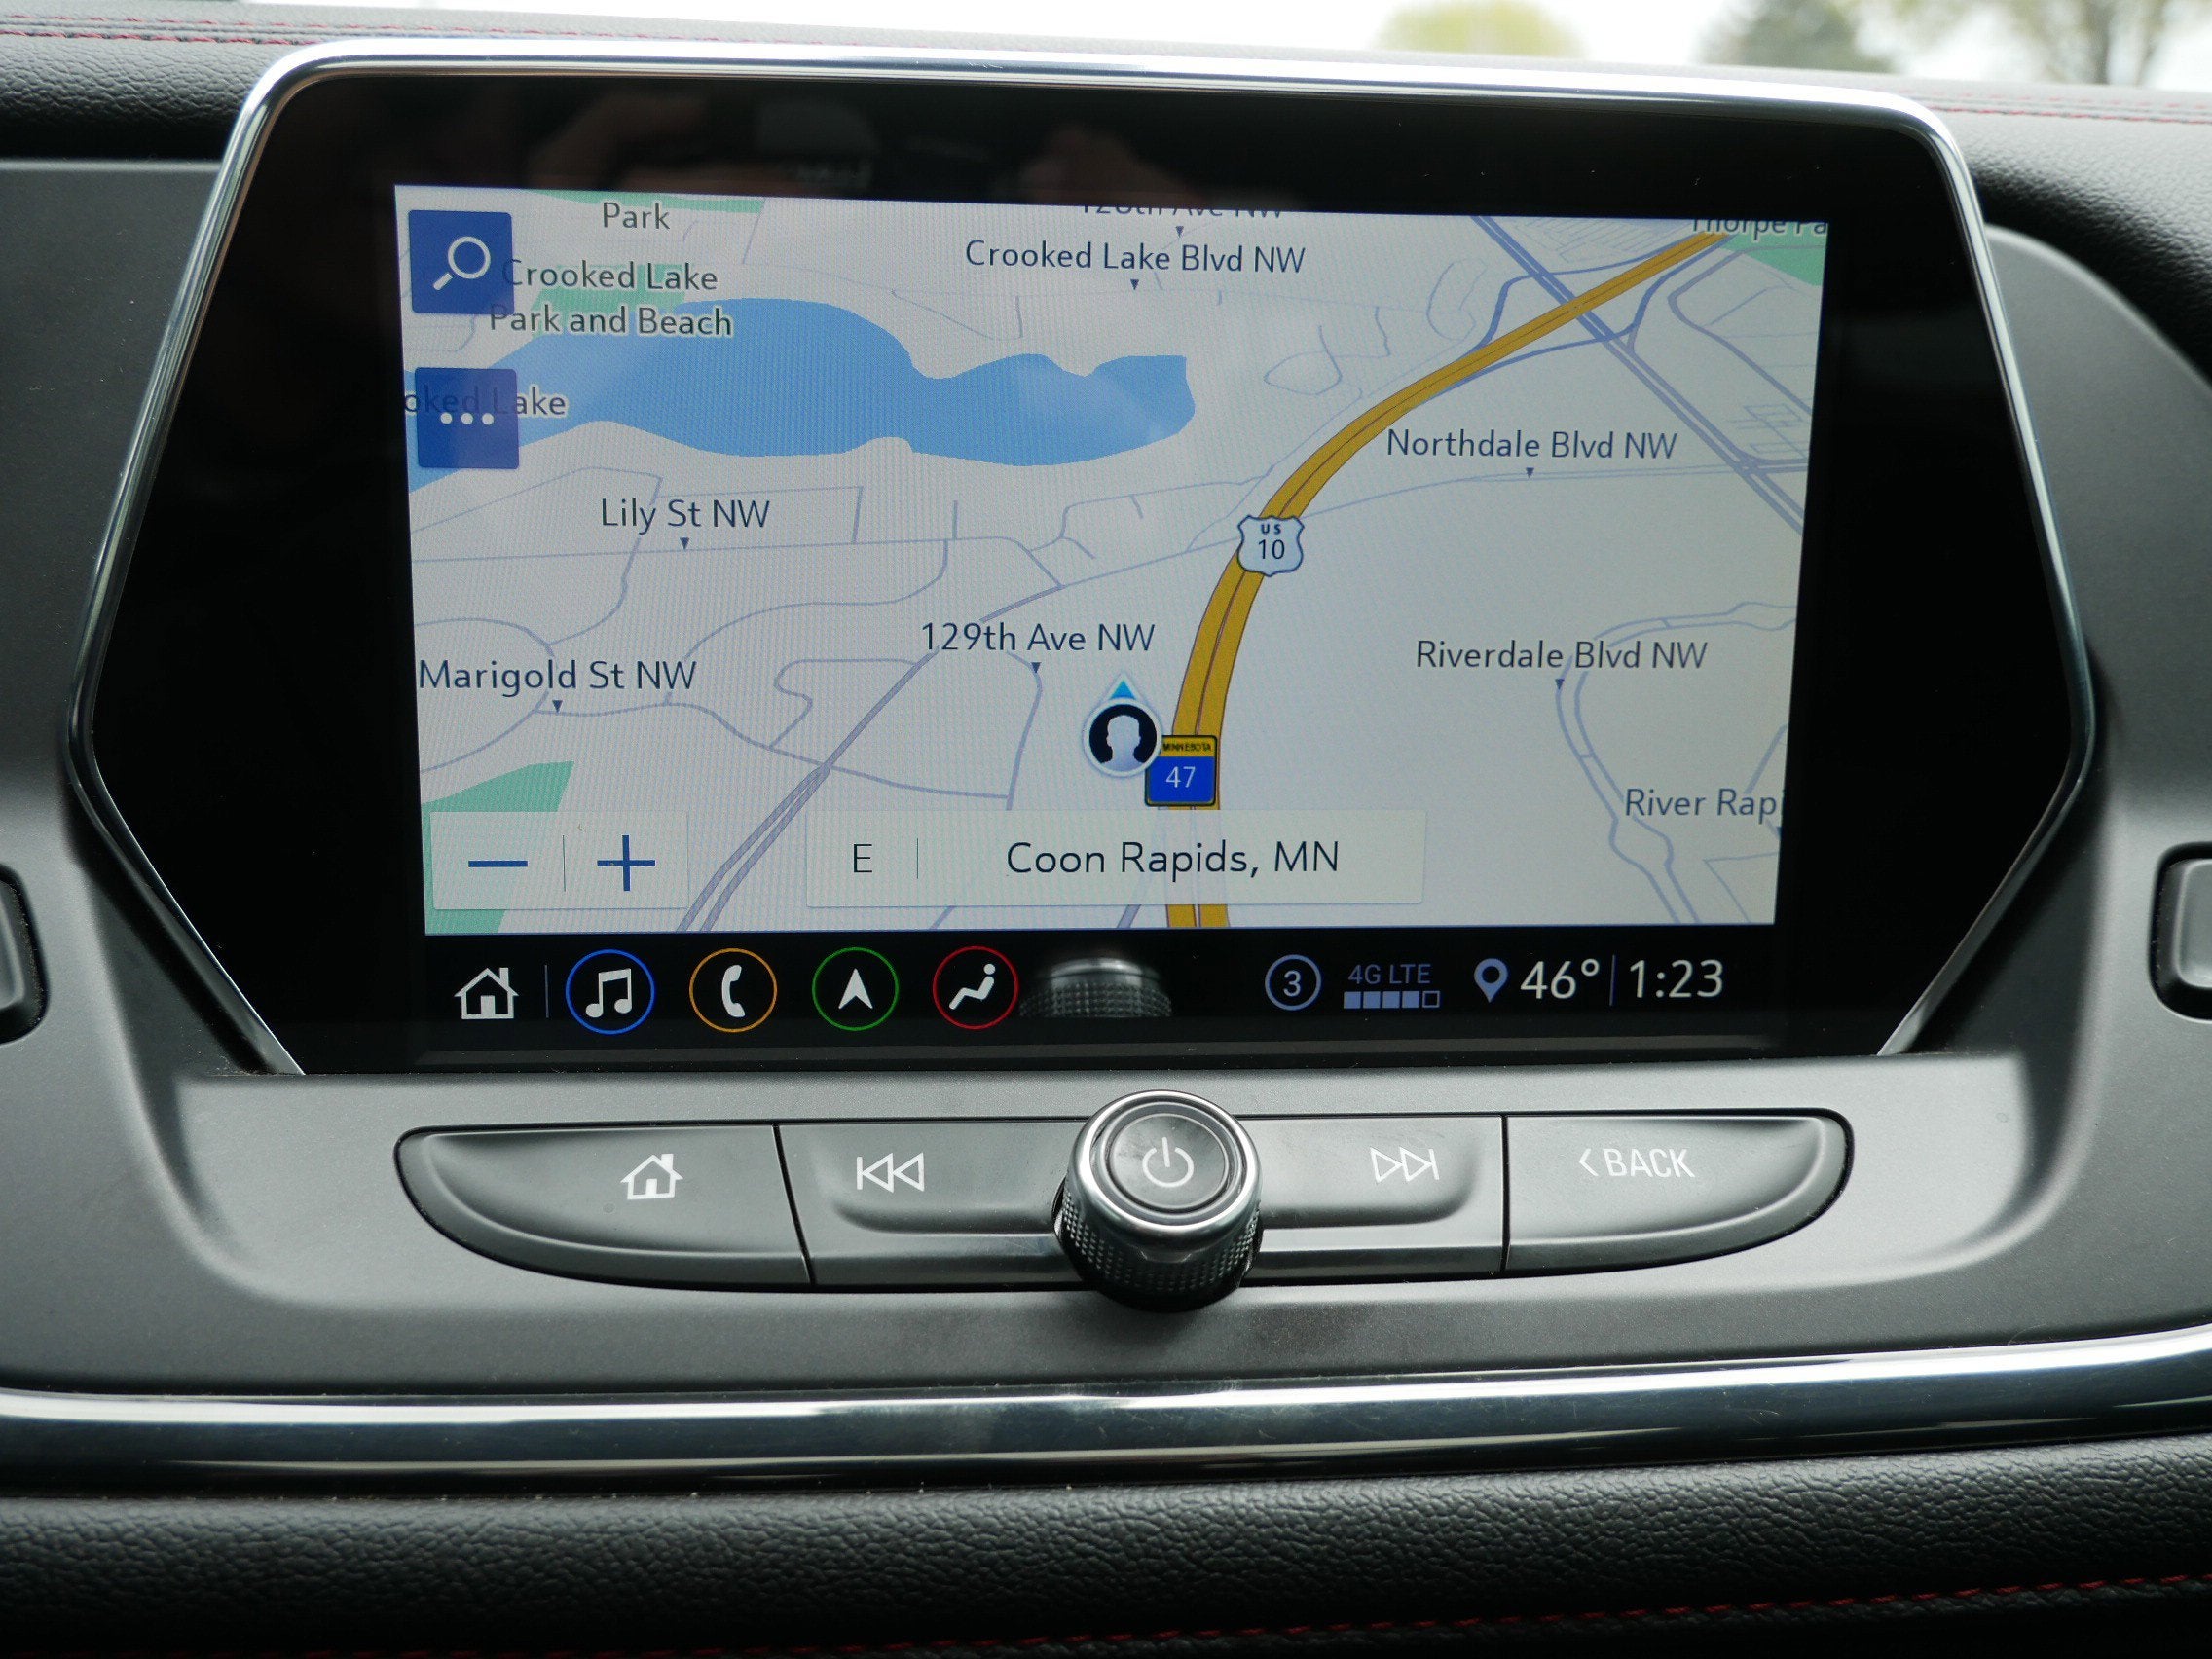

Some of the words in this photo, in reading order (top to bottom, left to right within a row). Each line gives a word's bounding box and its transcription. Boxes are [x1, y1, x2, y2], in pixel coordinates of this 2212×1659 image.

[603, 202, 672, 230] Park
[965, 240, 1091, 269] Crooked
[1103, 242, 1170, 270] Lake
[1181, 244, 1243, 272] Blvd
[1254, 245, 1306, 274] NW
[502, 259, 635, 289] Crooked
[647, 262, 719, 291] Lake
[490, 303, 561, 332] Park
[570, 305, 626, 334] and
[639, 307, 732, 336] Beach
[493, 387, 567, 416] Lake
[1386, 429, 1541, 458] Northdale
[1552, 431, 1613, 459] Blvd
[1625, 433, 1677, 460] NW
[601, 498, 657, 535] Lily
[667, 499, 704, 528] St
[713, 500, 770, 528] NW
[1261, 524, 1281, 535] US
[1258, 539, 1285, 560] 10
[921, 623, 1016, 650] 129th
[1027, 623, 1087, 650] Ave
[1097, 624, 1156, 651] NW
[1417, 640, 1564, 668] Riverdale
[1575, 641, 1641, 669] Blvd
[1652, 642, 1708, 669] NW
[419, 659, 576, 698] Marigold
[589, 661, 626, 689] St
[637, 661, 697, 689] NW
[1165, 766, 1196, 788] 47
[1625, 789, 1706, 816] River
[853, 844, 872, 873] E
[1007, 842, 1105, 873] Coon
[1122, 840, 1259, 882] Rapids,
[1274, 841, 1339, 872] MN
[1282, 971, 1302, 997] 3
[1348, 965, 1381, 984] 4G
[1390, 964, 1431, 984] LTE
[1520, 958, 1600, 1000] 46°
[1630, 958, 1723, 998] 1:23
[1604, 1149, 1696, 1178] BACK
